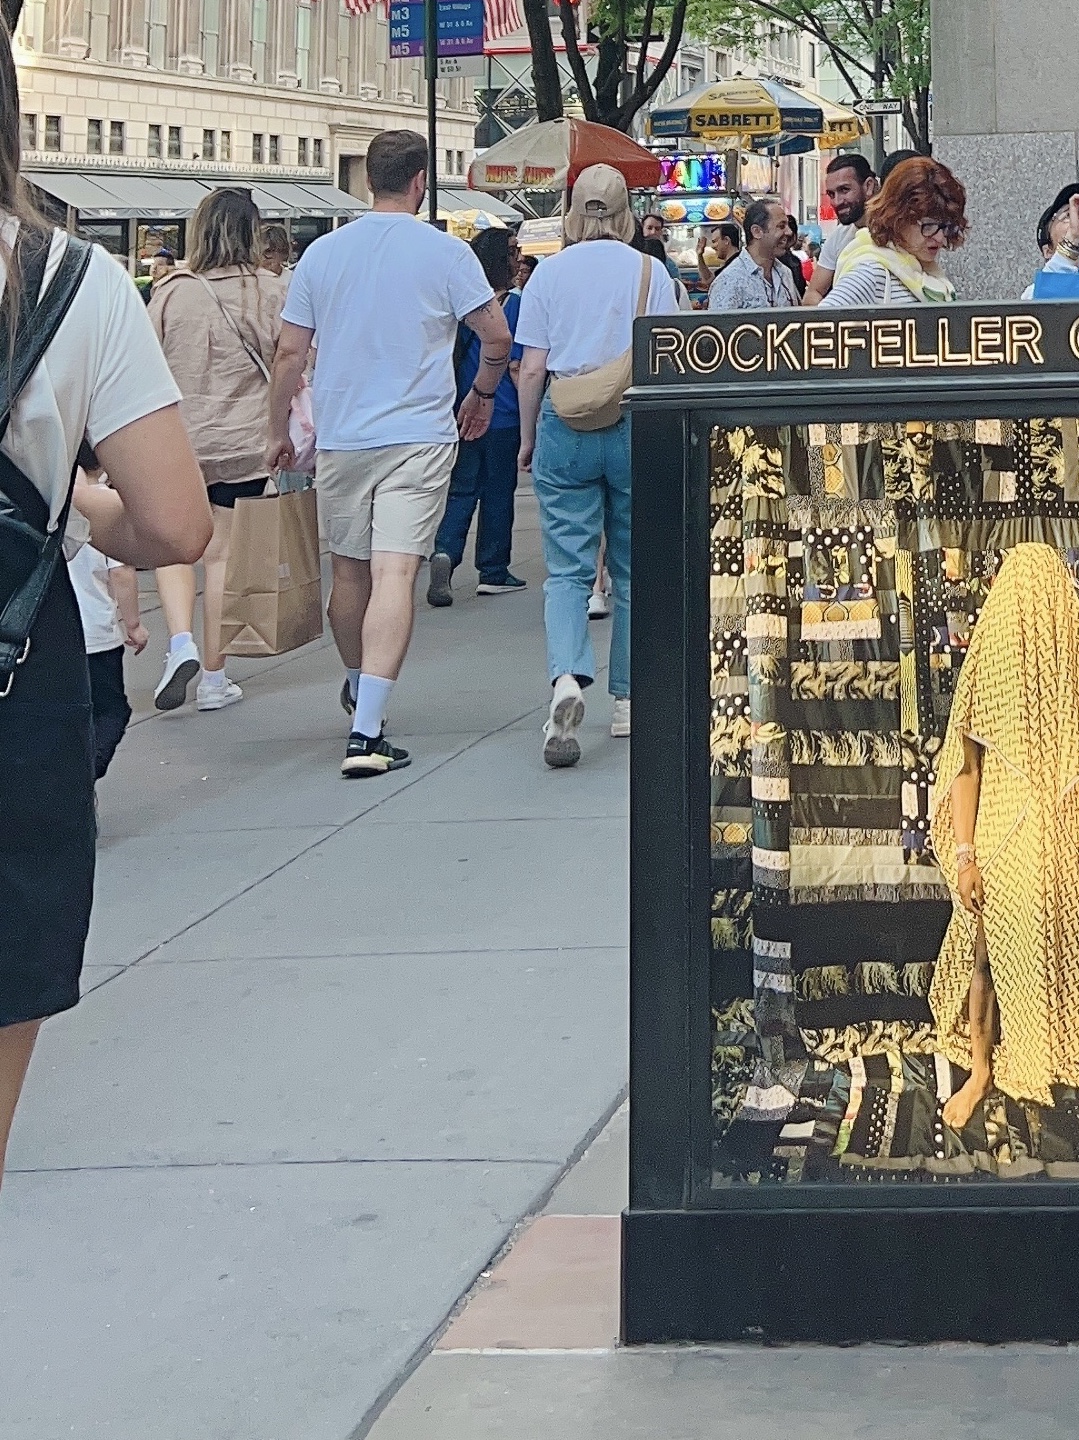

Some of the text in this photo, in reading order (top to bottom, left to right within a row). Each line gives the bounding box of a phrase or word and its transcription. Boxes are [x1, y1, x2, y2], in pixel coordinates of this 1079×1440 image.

[391, 7, 410, 20] M3
[391, 25, 410, 38] M5
[391, 42, 410, 55] M5
[695, 112, 774, 127] SABRETT
[827, 121, 853, 132] ETT
[649, 315, 1044, 375] ROCKEFELLER
